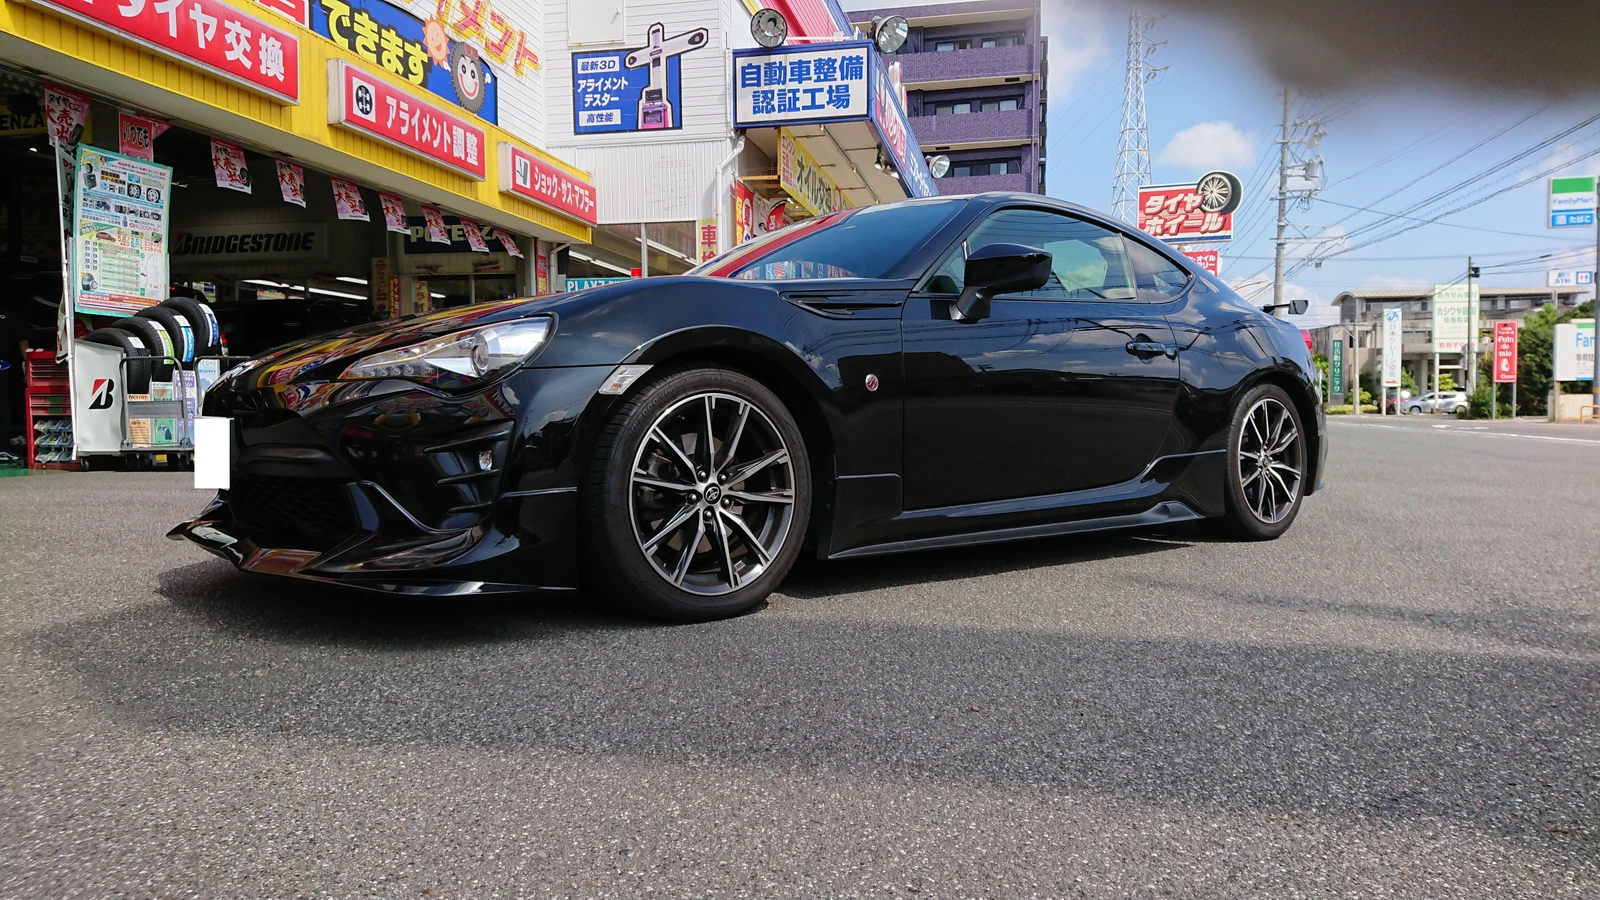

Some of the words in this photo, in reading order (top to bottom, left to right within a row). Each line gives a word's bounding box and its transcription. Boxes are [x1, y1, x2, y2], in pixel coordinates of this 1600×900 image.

[321, 0, 428, 85] できます
[580, 60, 616, 72] 最新3D
[741, 55, 864, 88] 自動車整備
[577, 76, 628, 93] アライメント
[48, 93, 69, 108] タイヤ
[584, 92, 620, 107] テスター
[752, 84, 851, 115] 認証工場
[586, 112, 614, 123] 高性能
[122, 120, 150, 149] いつでも
[386, 95, 479, 167] アライメント調整
[534, 162, 595, 214] ショック・サス・マフラー
[1144, 192, 1204, 213] タイヤ
[1553, 197, 1594, 205] FamilyMart
[1143, 212, 1224, 235] ホイール
[172, 231, 316, 256] BRIDGESTONE
[1437, 306, 1477, 316] カシワヤ
